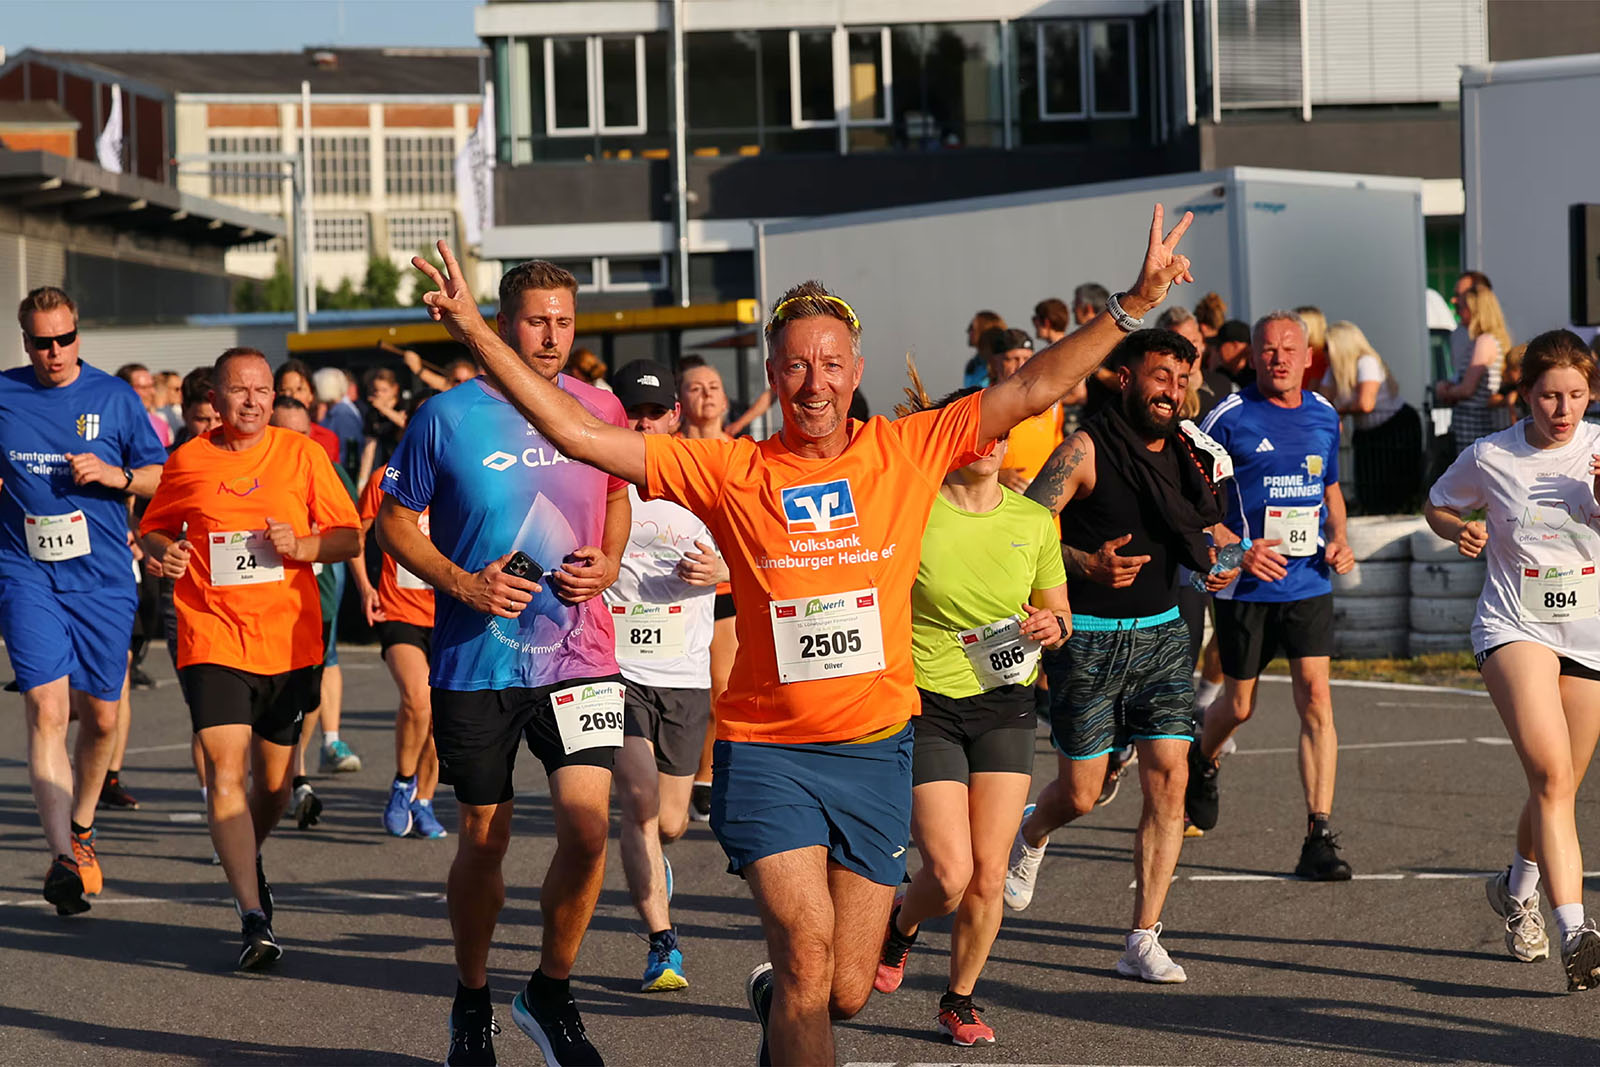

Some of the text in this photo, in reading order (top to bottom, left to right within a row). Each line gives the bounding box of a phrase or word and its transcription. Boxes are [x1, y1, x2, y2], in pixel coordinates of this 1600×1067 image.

[522, 447, 581, 468] CLA
[1263, 475, 1304, 487] PRIME
[1269, 484, 1322, 499] RUNNERS
[38, 534, 74, 549] 2114
[789, 533, 861, 553] Volksbank
[1289, 530, 1307, 543] 84
[236, 555, 257, 570] 24
[755, 554, 834, 570] Lüneburger
[838, 549, 879, 564] Heide
[1544, 591, 1577, 609] 894
[630, 628, 661, 644] 821
[800, 629, 862, 659] 2505
[824, 662, 843, 670] Oliver
[989, 646, 1025, 671] 886
[579, 711, 623, 732] 2699
